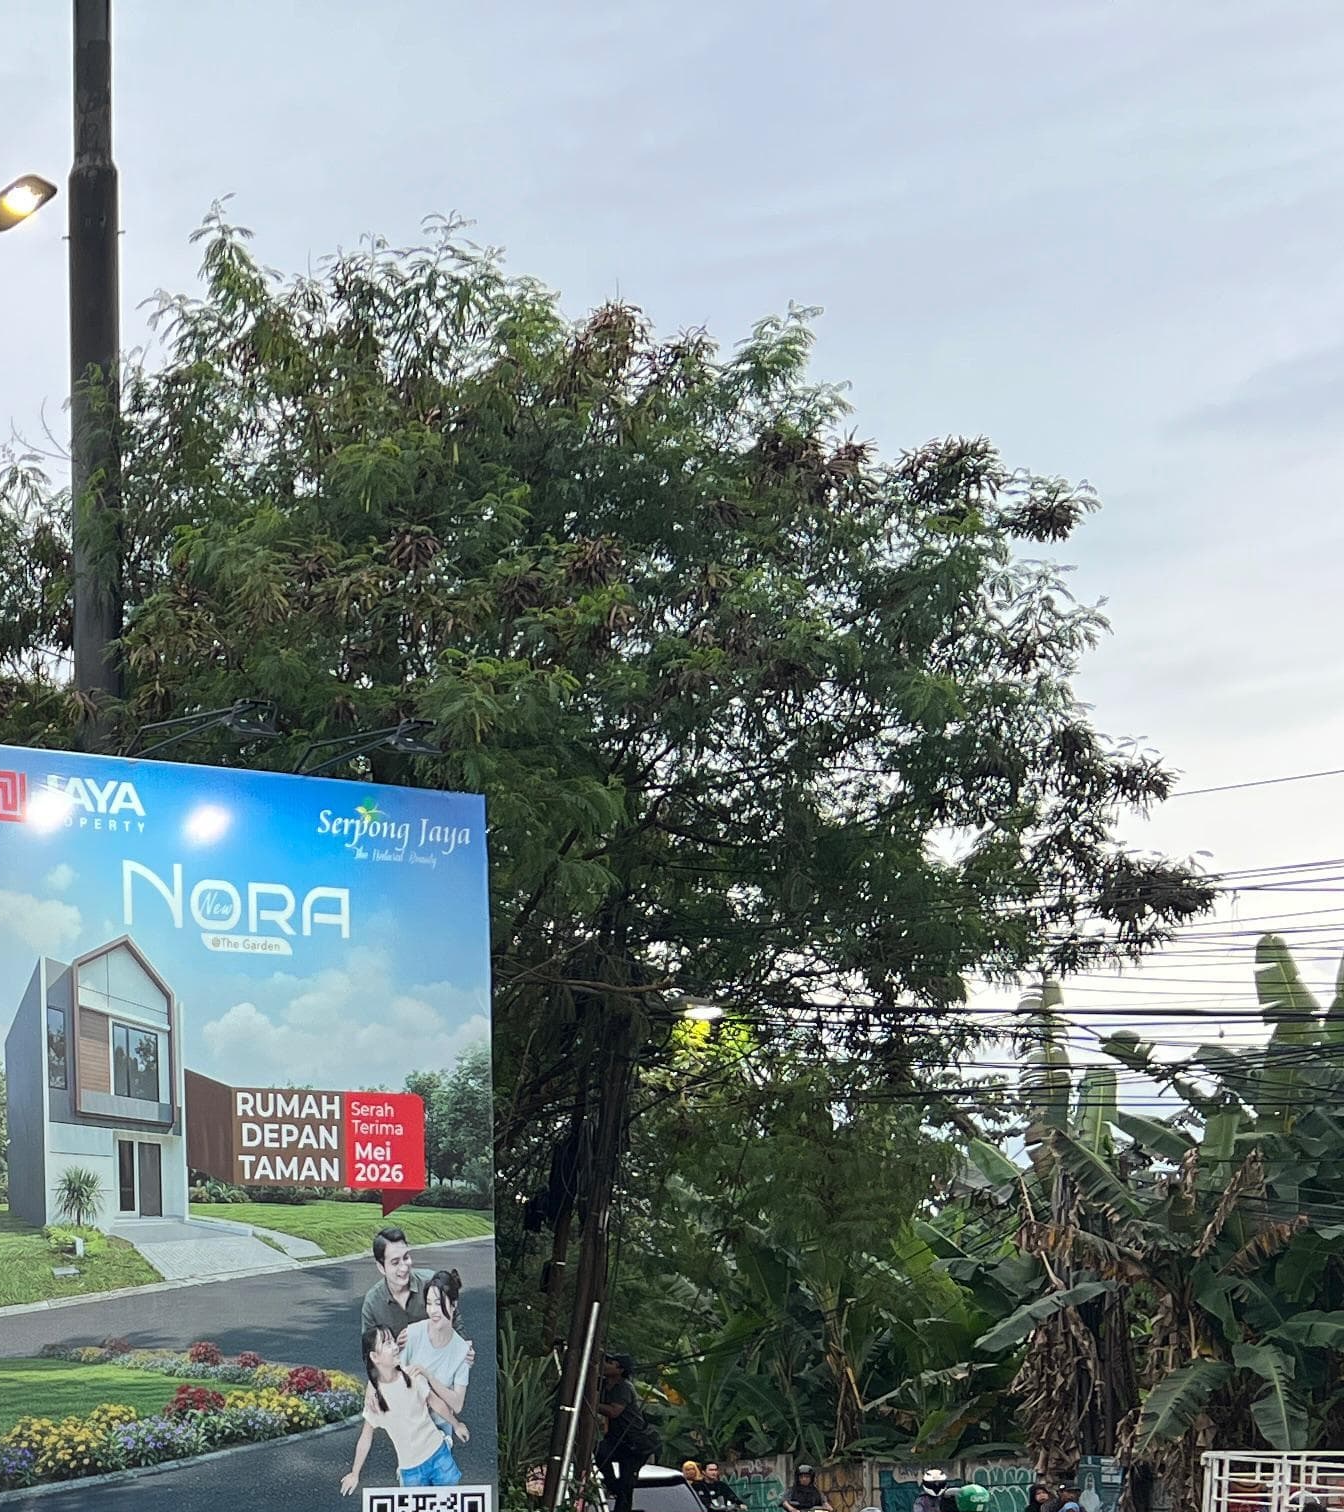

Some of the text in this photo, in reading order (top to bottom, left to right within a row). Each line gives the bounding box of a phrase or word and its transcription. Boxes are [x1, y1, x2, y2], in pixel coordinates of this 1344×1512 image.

[317, 809, 471, 855] Serpong Jaya
[122, 859, 351, 939] NORA
[198, 890, 233, 915] New
[242, 939, 281, 951] Garden
[236, 1092, 341, 1120] RUMAH
[351, 1102, 395, 1118] Serah
[241, 1122, 338, 1150] DEPAN
[351, 1120, 404, 1136] Terima
[354, 1141, 392, 1161] Mei
[238, 1154, 340, 1182] TAMAN
[355, 1164, 404, 1183] 2026
